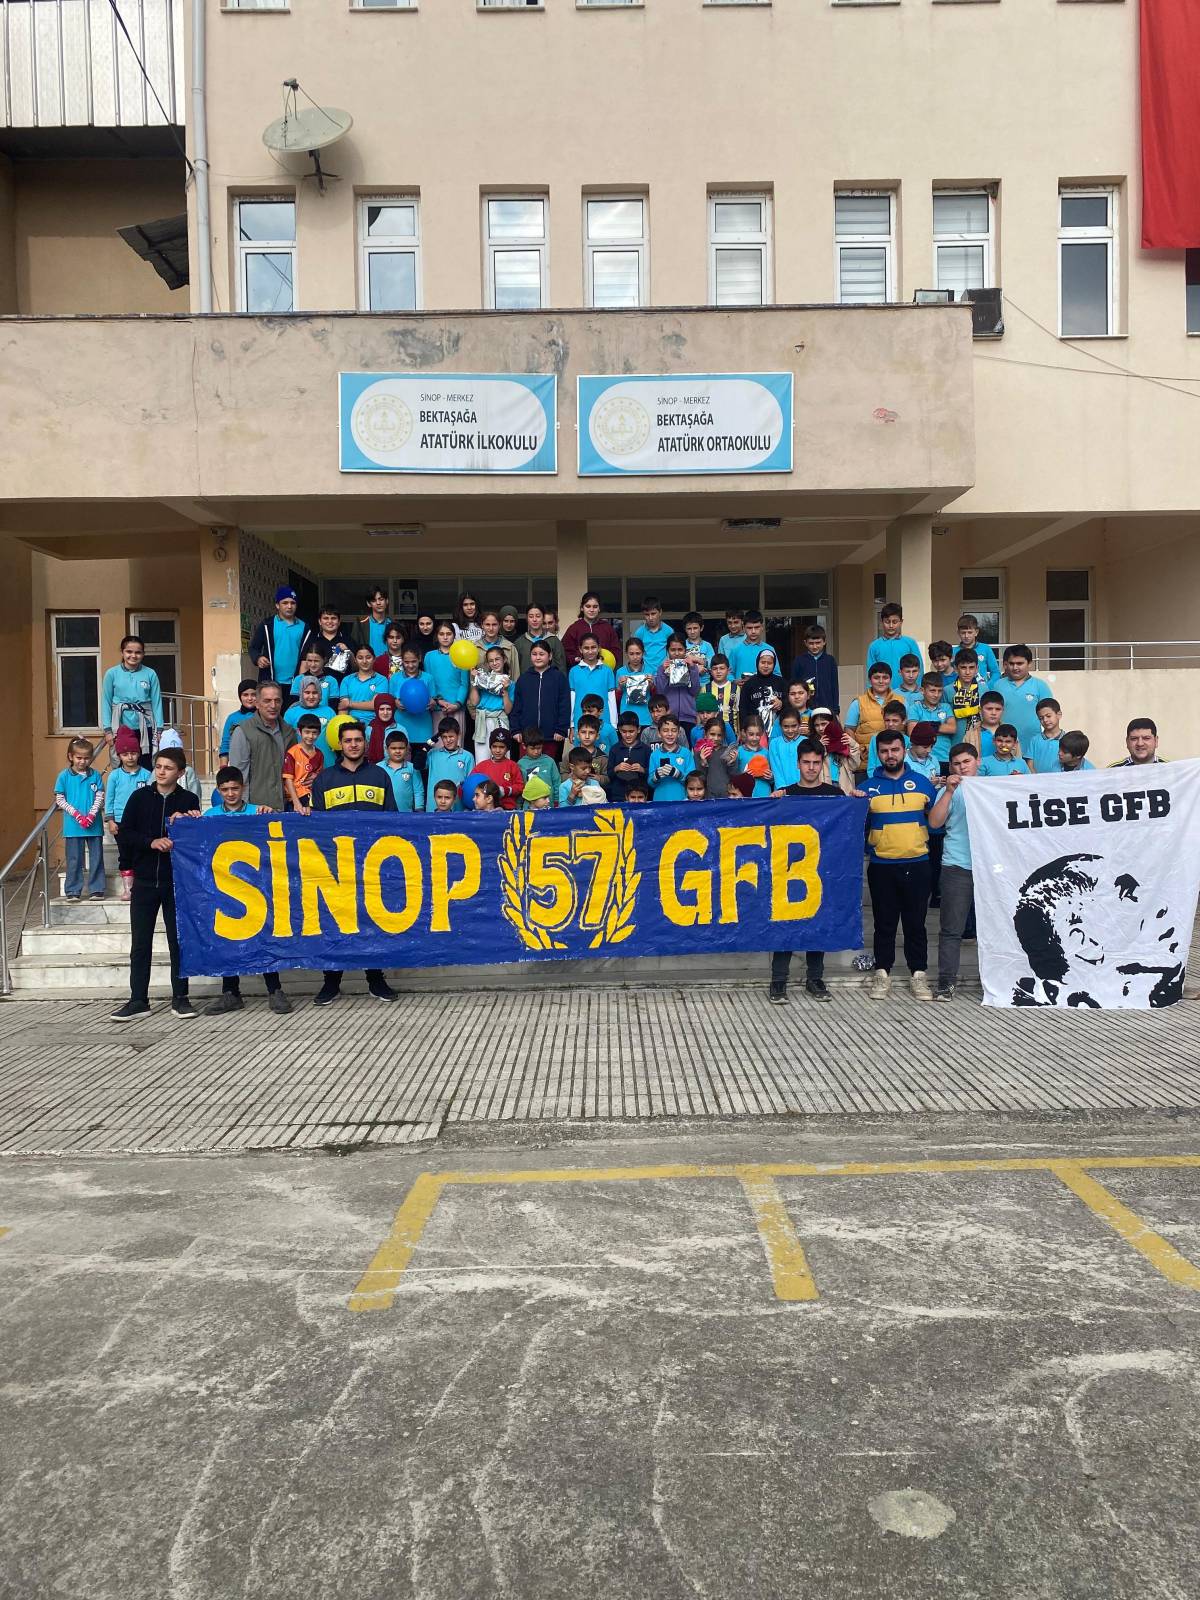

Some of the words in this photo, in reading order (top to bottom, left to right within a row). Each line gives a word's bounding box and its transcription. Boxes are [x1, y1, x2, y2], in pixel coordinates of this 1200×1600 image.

[446, 393, 474, 402] MERKEZ
[683, 396, 710, 405] MERKEZ
[419, 409, 477, 426] BEKTAŞAĞA
[656, 411, 714, 428] BEKTAŞAĞA
[420, 430, 475, 450] ATATÜRK
[477, 431, 537, 451] İLKOKULU
[657, 433, 705, 452] ATATÜRK
[706, 435, 771, 452] ORTAOKULU
[1006, 794, 1090, 829] LİSE
[1100, 788, 1171, 822] GFB
[211, 821, 481, 940] SİNOP
[526, 832, 621, 931] 57
[658, 824, 822, 927] GFB
